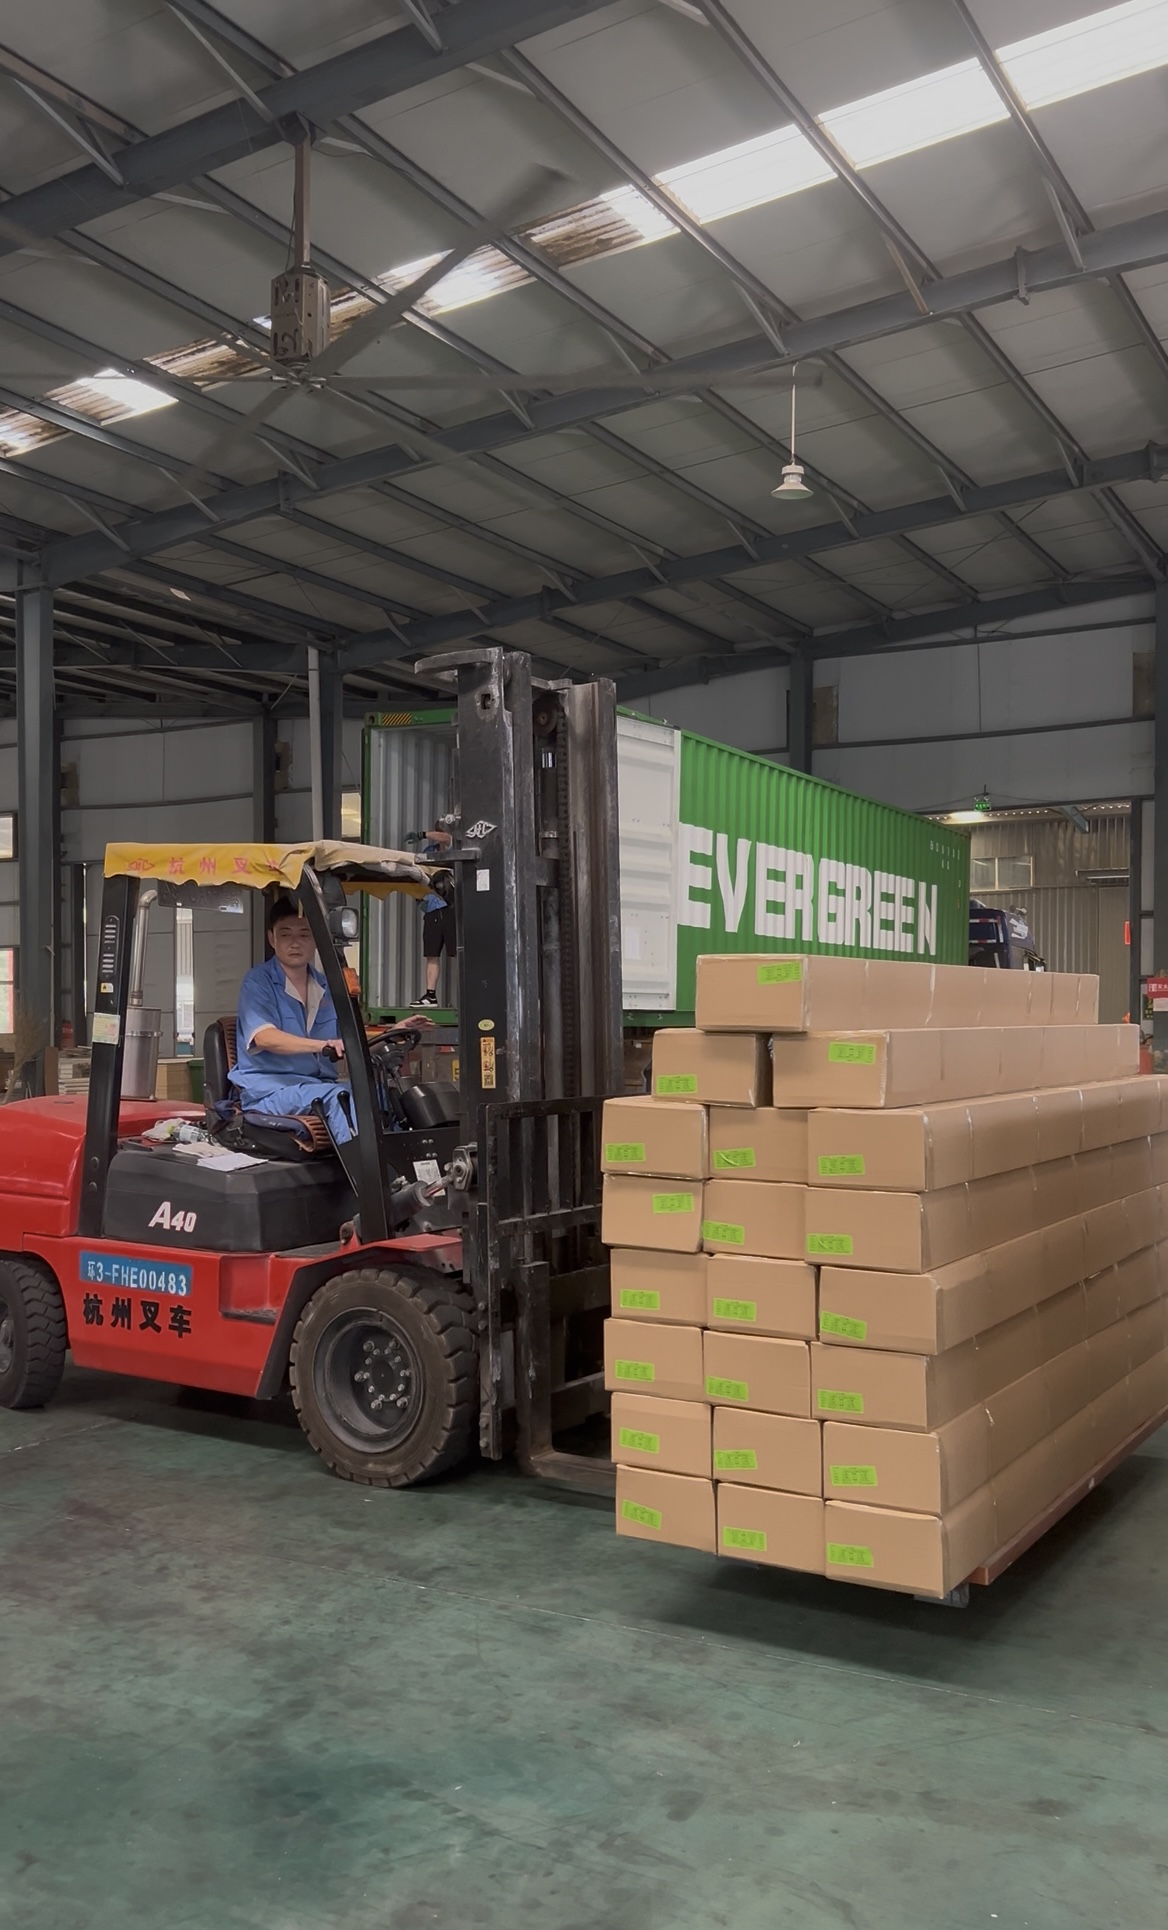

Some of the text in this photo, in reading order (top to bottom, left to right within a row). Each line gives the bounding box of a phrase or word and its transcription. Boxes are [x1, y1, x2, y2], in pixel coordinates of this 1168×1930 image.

[677, 821, 937, 956] EVERGREEN
[147, 1201, 198, 1233] A40
[82, 1292, 193, 1339] 杭州叉车
